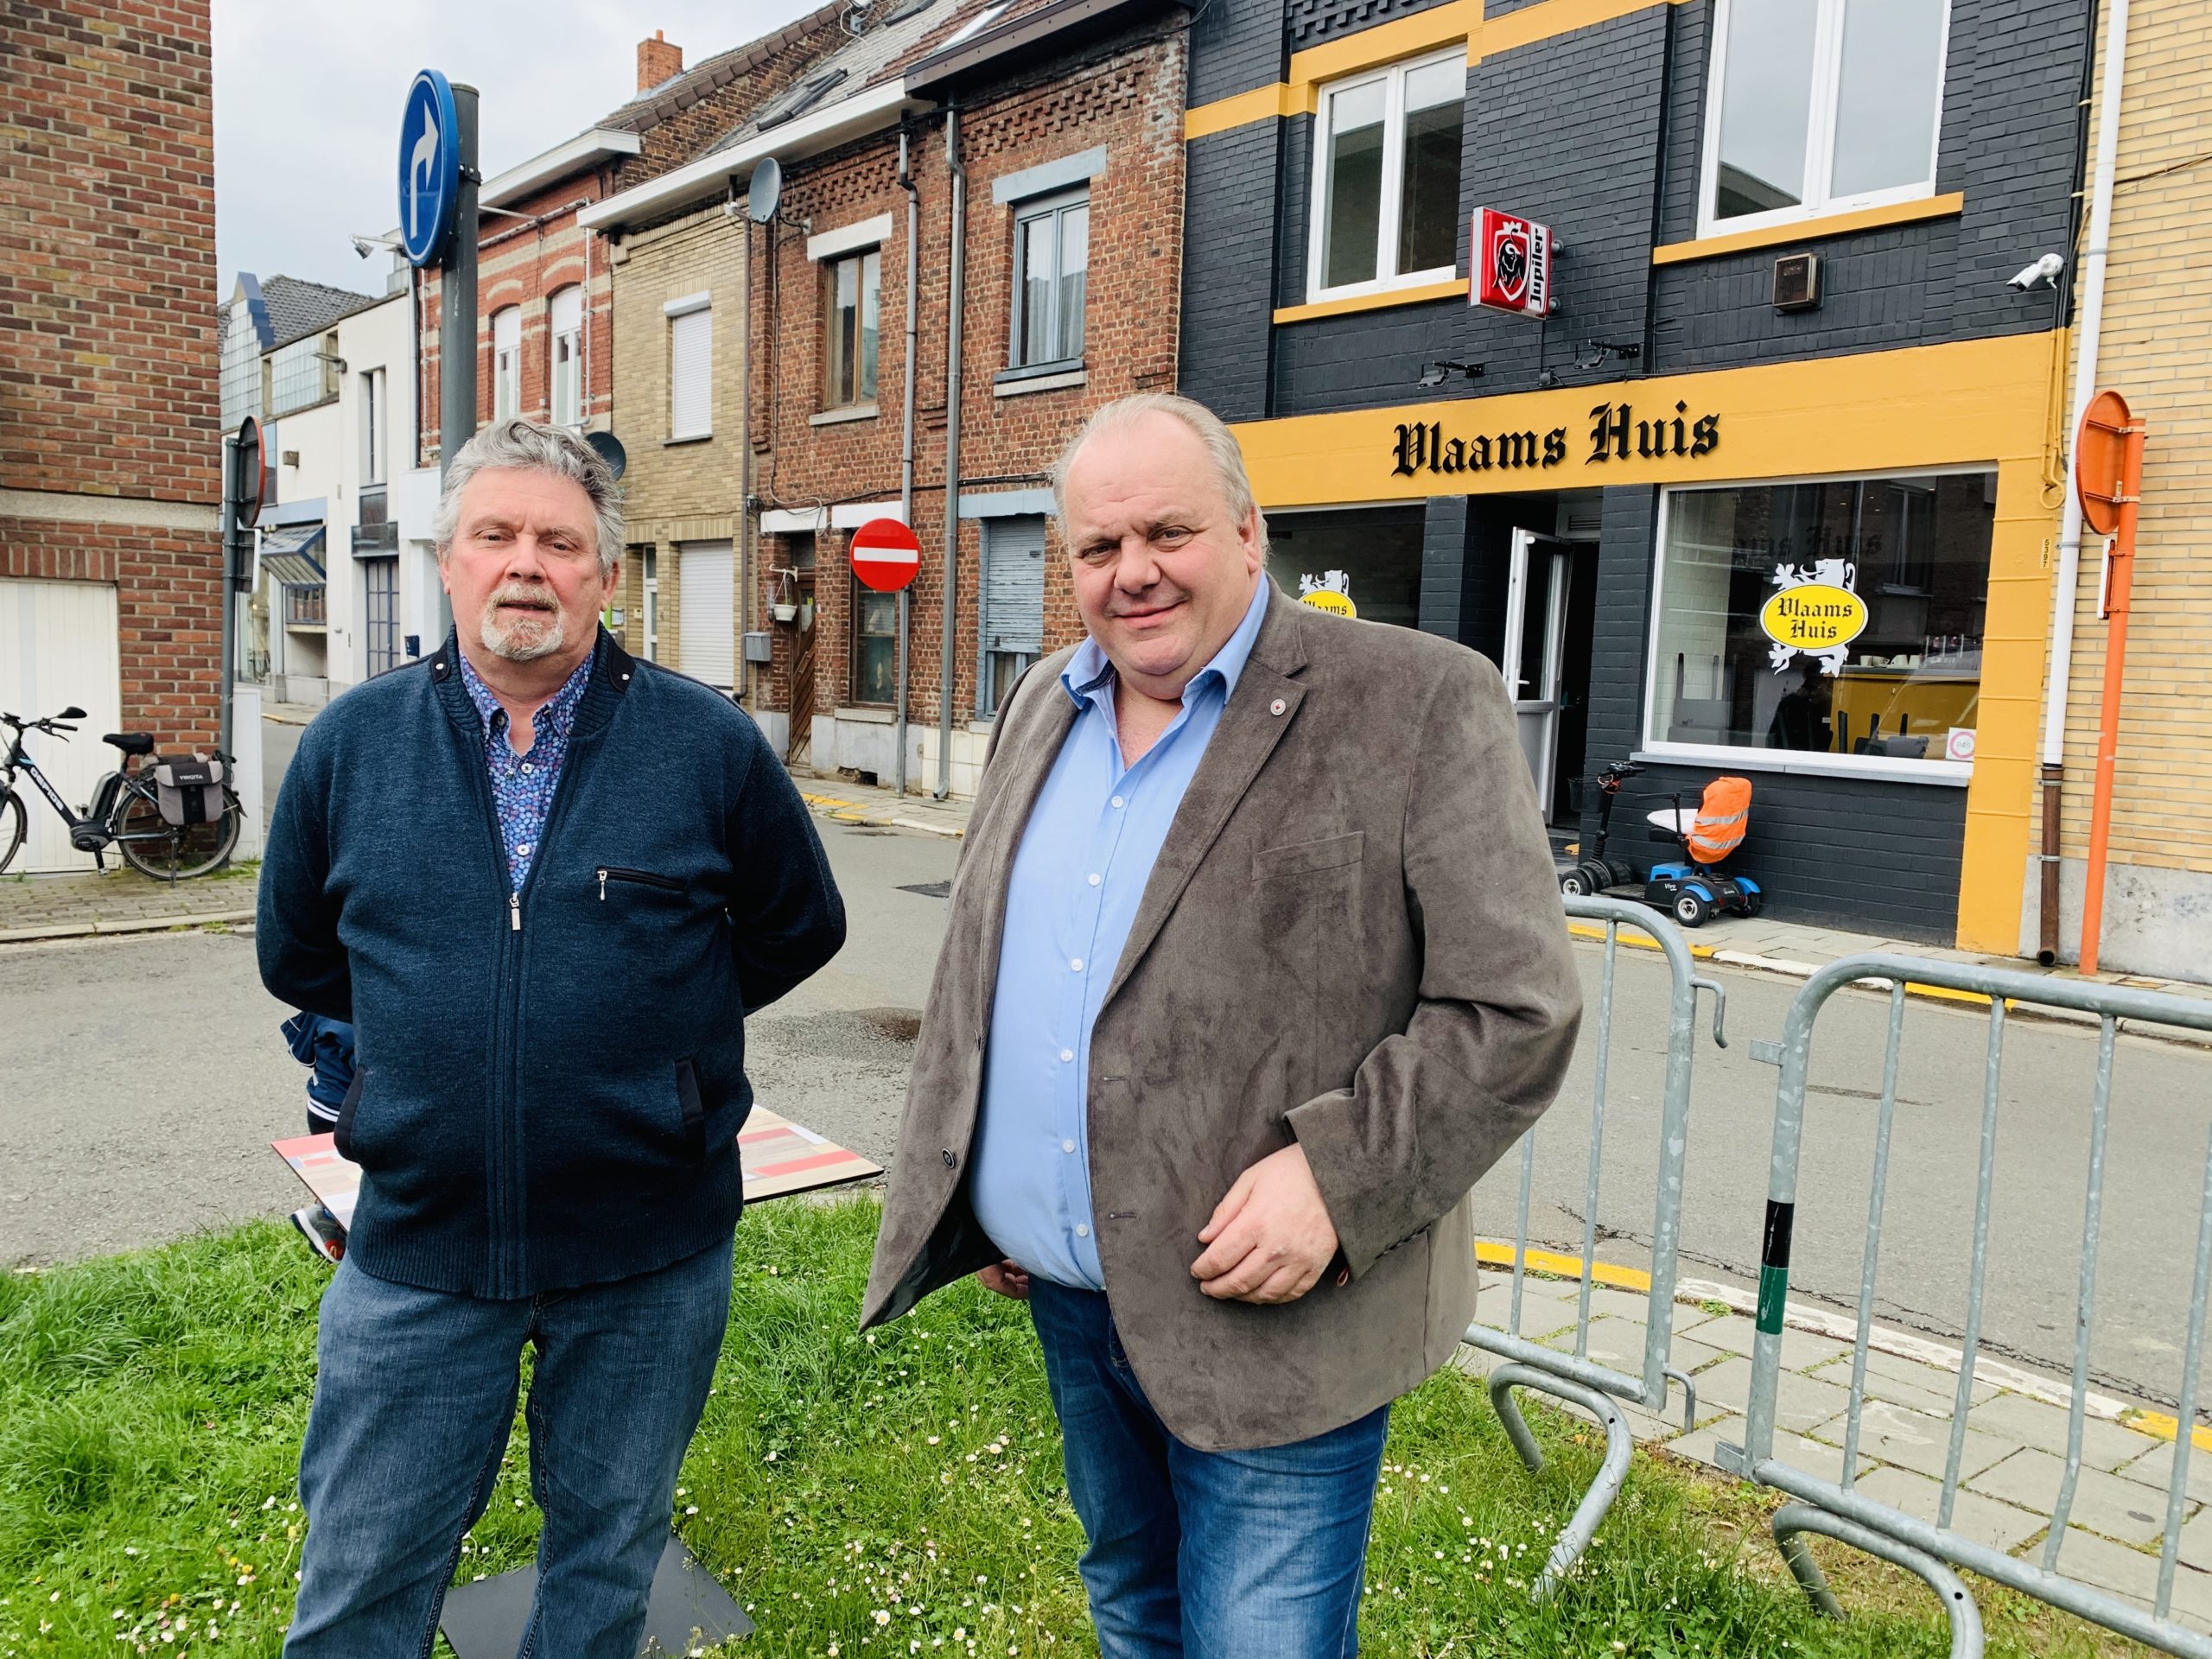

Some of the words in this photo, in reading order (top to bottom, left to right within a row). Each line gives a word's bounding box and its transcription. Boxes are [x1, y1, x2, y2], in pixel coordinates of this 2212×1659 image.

[1529, 227, 1545, 309] Jupiler
[1391, 420, 1567, 478] Vlaams
[1585, 399, 1720, 466] Huis
[1777, 597, 1853, 618] Vlaams
[1789, 619, 1838, 640] Huis
